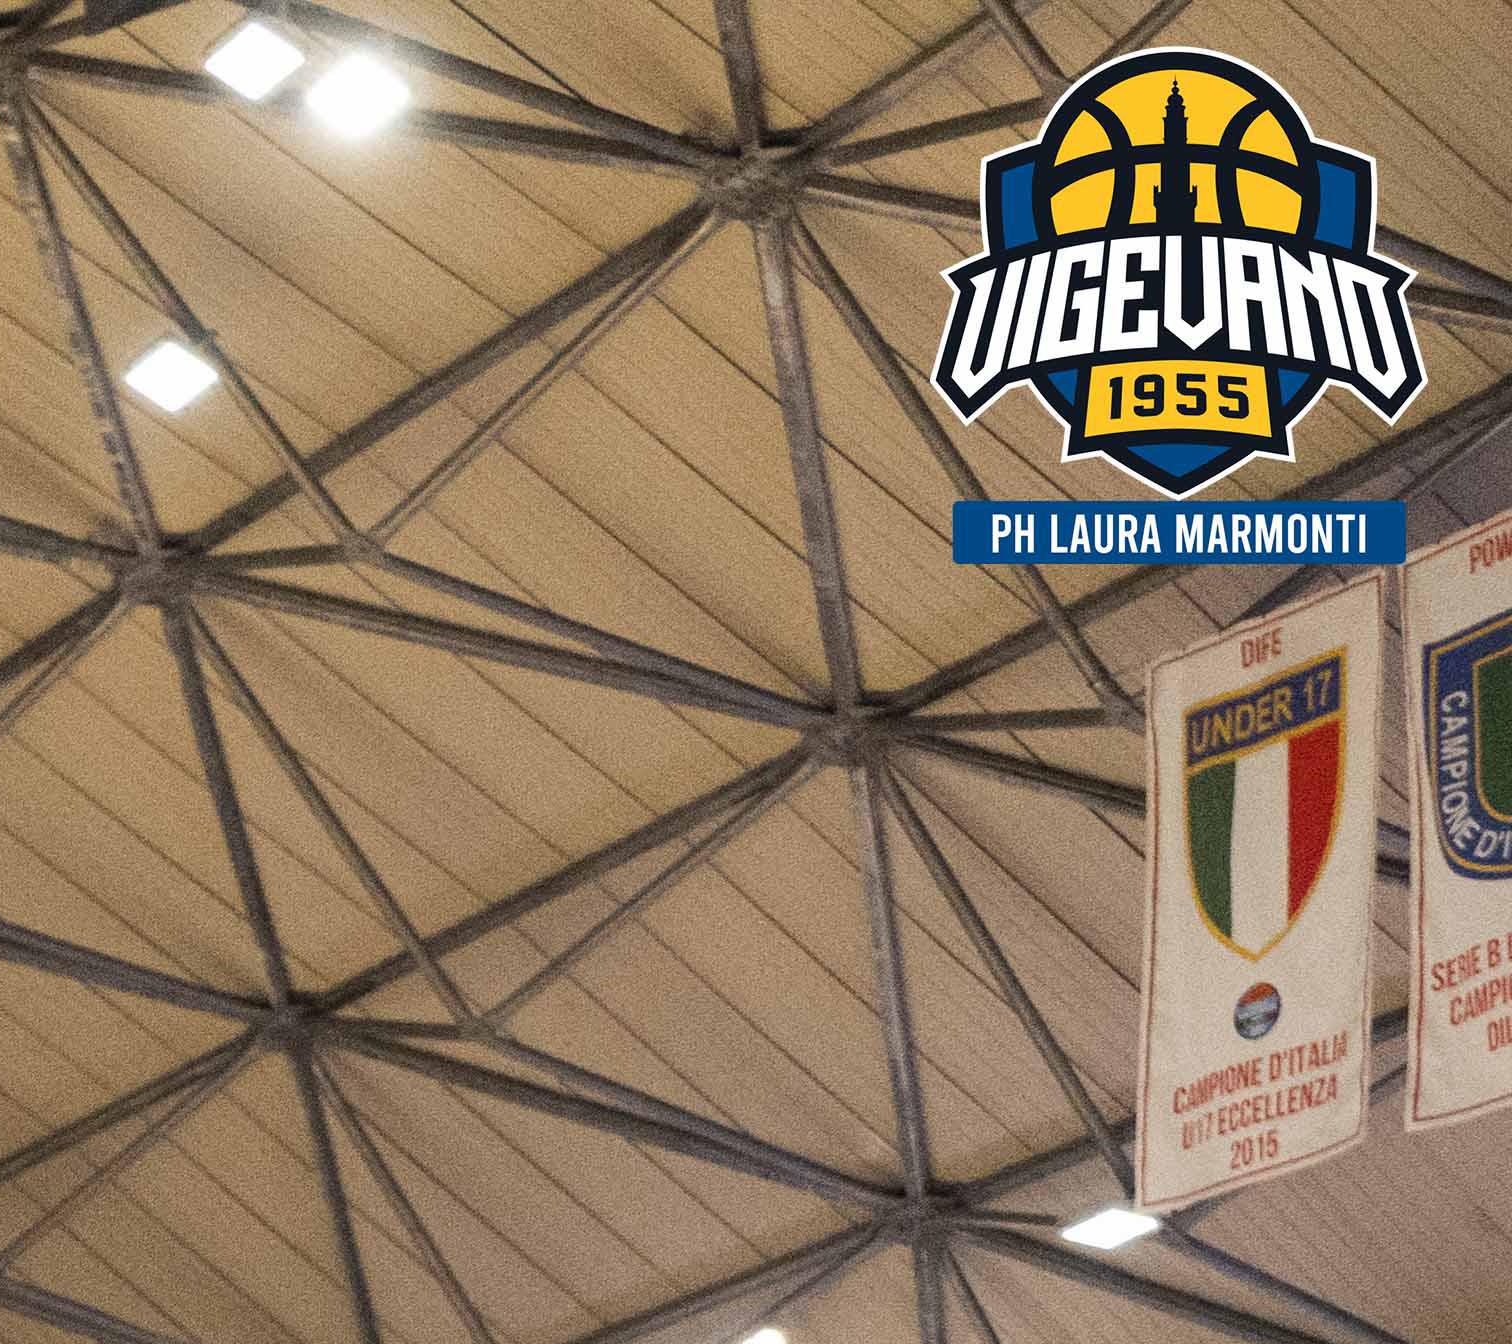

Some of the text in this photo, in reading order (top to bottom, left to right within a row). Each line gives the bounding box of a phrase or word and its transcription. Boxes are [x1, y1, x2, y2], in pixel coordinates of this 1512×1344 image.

[1239, 627, 1283, 669] DIFE
[1190, 669, 1333, 754] UNDER 17
[1441, 690, 1480, 848] CAMPIONE
[1488, 938, 1502, 969] B
[1172, 1029, 1348, 1116] CAMPIONE D'ITALIA
[1218, 1074, 1338, 1136] ECCELLENZA
[1230, 1129, 1279, 1170] 2015
